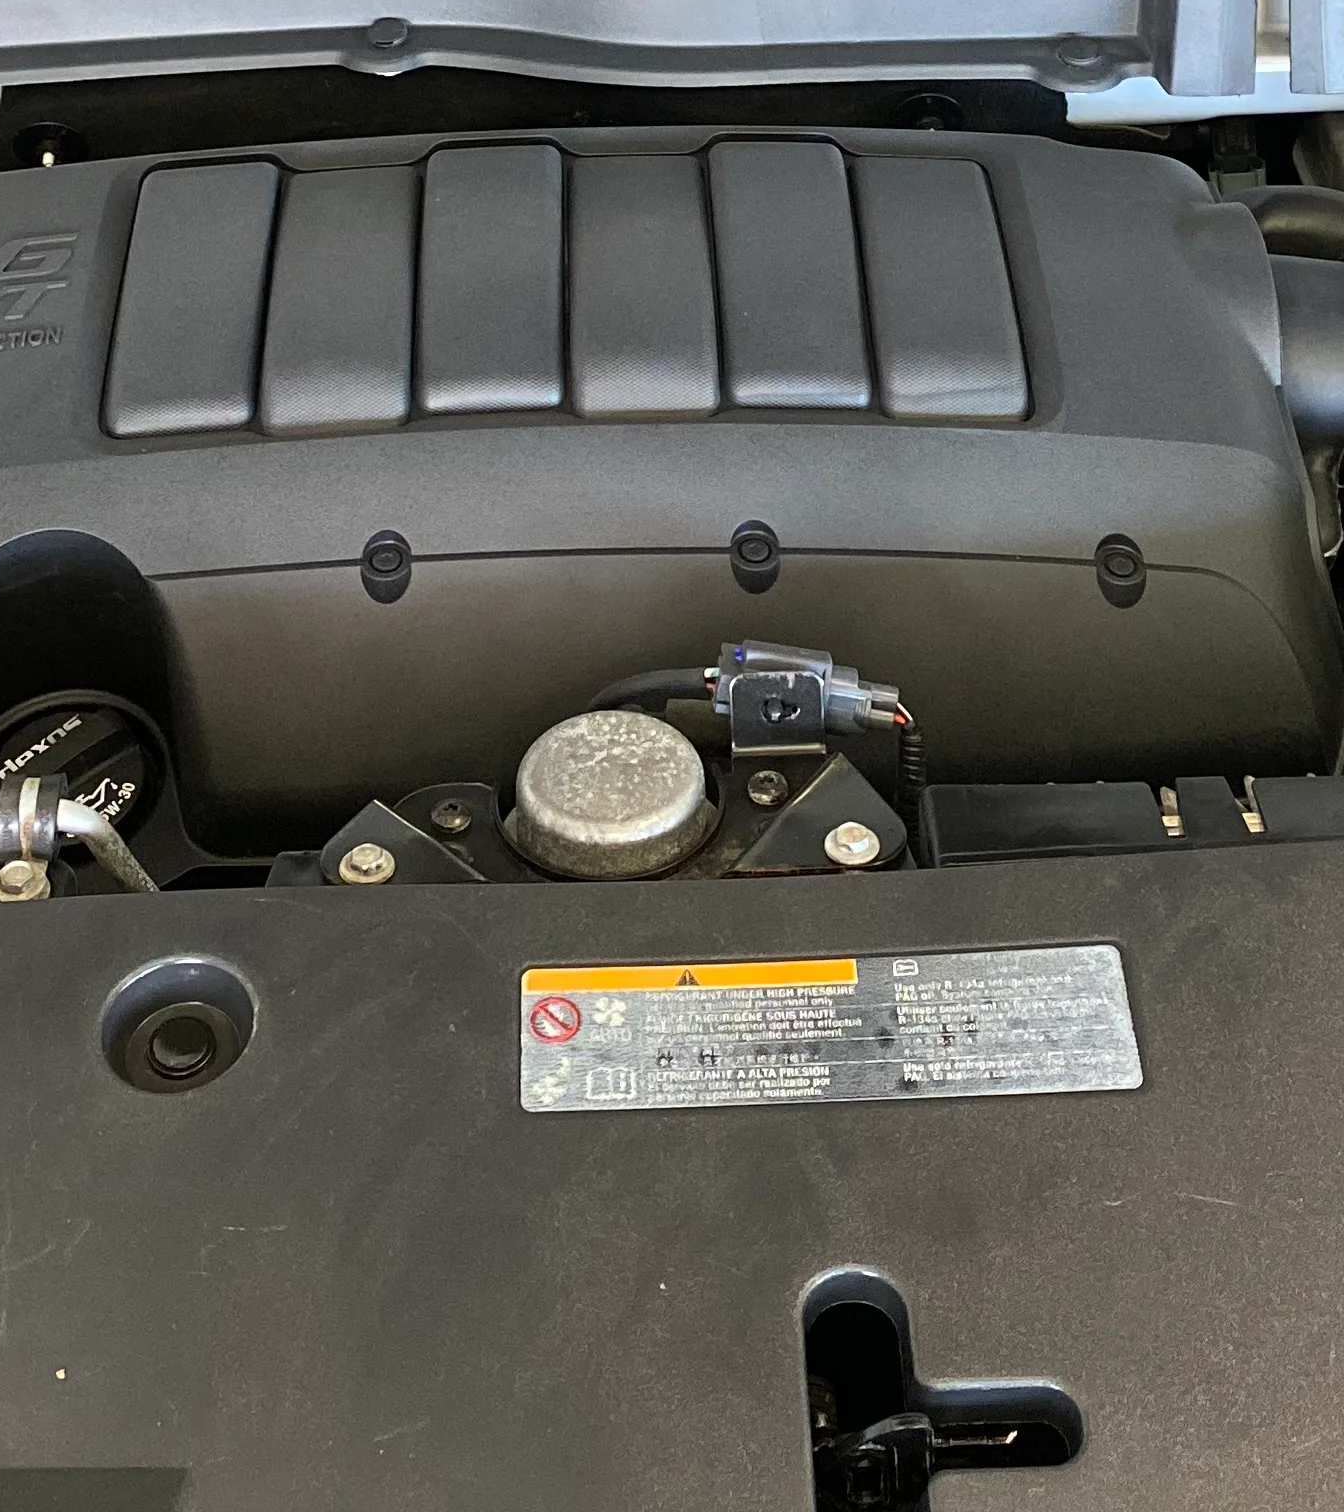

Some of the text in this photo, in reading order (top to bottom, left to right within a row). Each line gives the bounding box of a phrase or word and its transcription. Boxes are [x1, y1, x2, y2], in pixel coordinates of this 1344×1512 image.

[767, 988, 794, 998] HIGH
[797, 986, 855, 997] PRESSURE
[895, 991, 918, 1002] PAG
[811, 996, 834, 1007] only
[766, 1010, 796, 1021] SOUS
[799, 1009, 836, 1020] HAUTE
[736, 1069, 746, 1080] A
[748, 1067, 776, 1078] ALTA
[779, 1066, 830, 1077] PRESION
[759, 1076, 810, 1089] realizado
[812, 1078, 831, 1088] por
